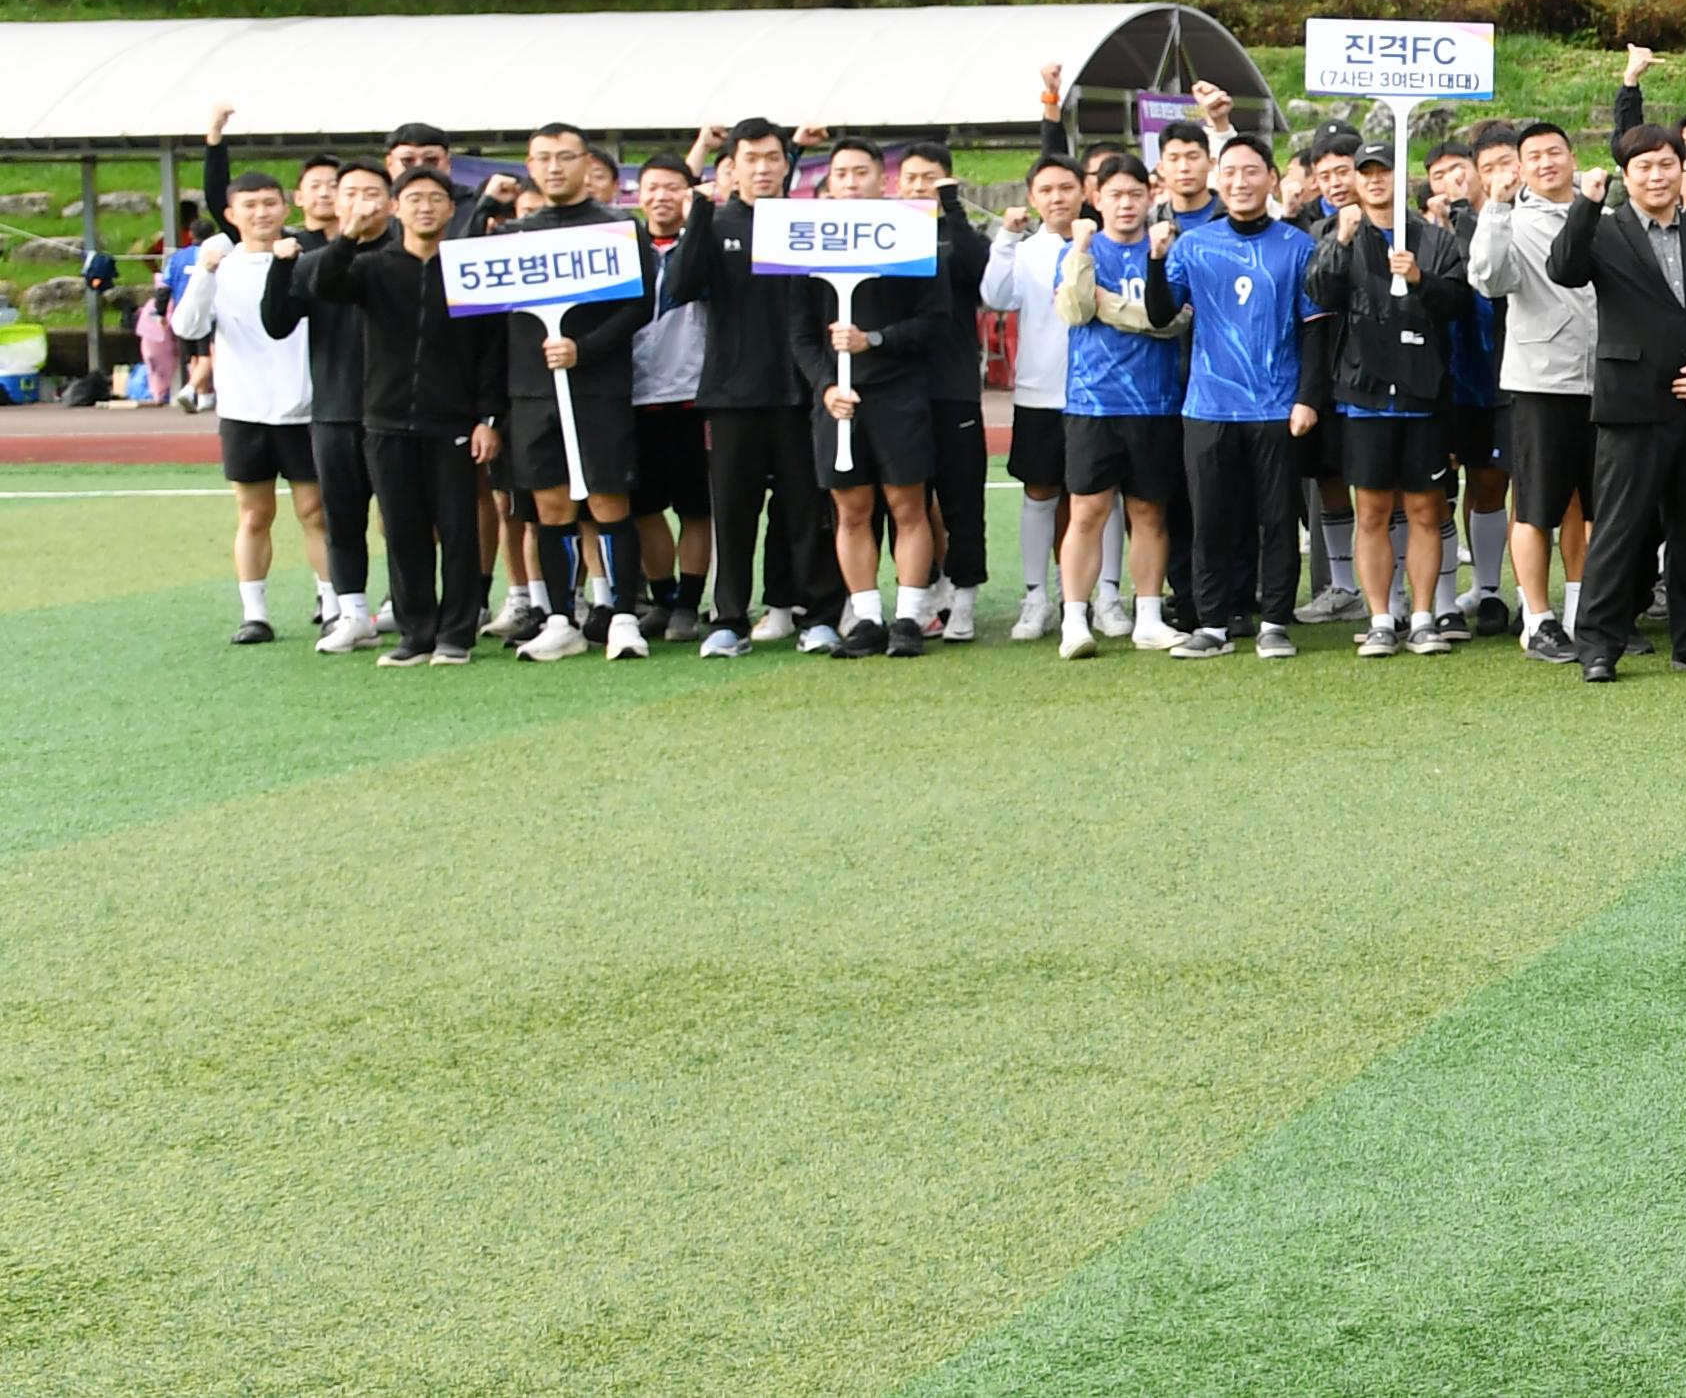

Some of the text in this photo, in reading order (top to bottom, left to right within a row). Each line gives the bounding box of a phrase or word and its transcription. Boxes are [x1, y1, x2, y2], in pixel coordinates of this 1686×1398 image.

[1345, 35, 1457, 66] 진격FC
[1320, 70, 1480, 91] (7사단 3여단1대대)
[788, 221, 896, 251] 통일FC
[459, 246, 621, 290] 5포병대대
[1234, 275, 1254, 306] 9
